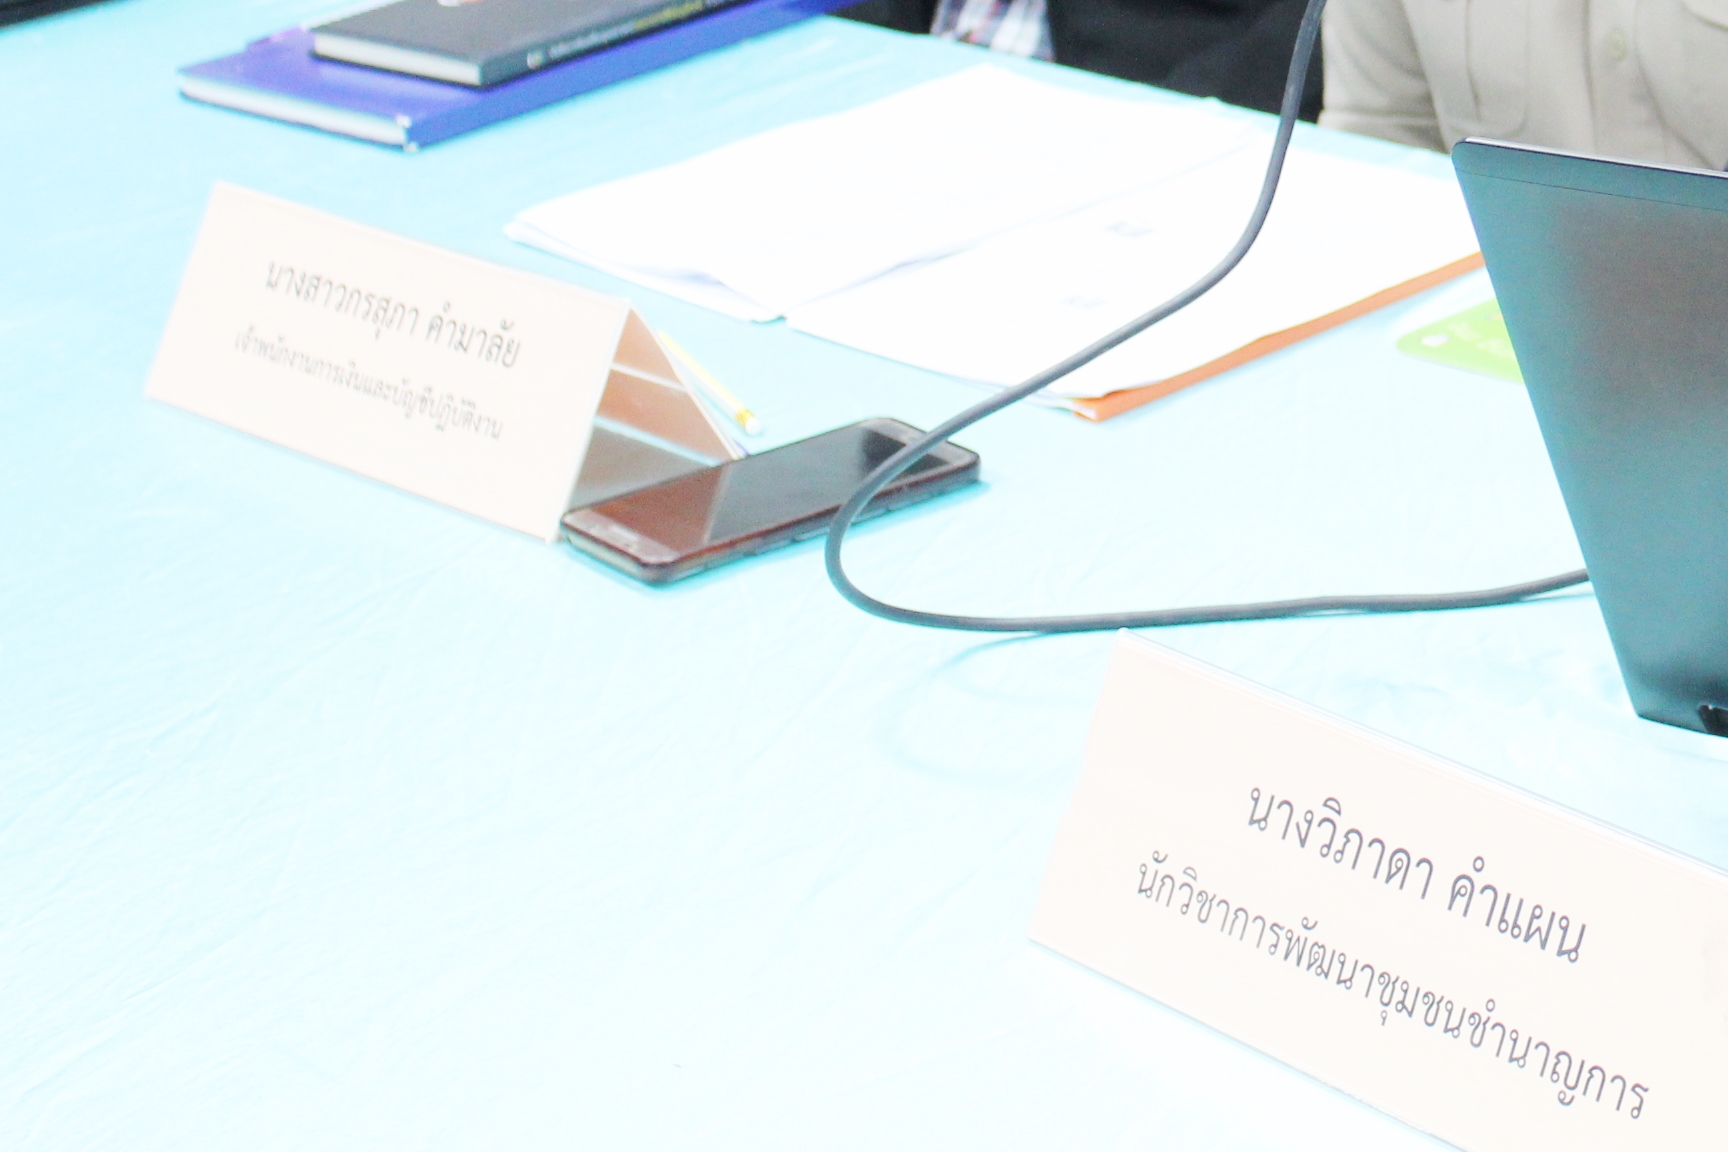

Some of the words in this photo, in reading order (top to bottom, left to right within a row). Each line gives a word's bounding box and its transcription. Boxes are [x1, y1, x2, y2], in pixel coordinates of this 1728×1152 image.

[234, 323, 504, 441] เจ้าพนักงานการเงินและบัญชีปฏิบัติงาน
[265, 260, 420, 340] นางสาวกรสุภา
[425, 301, 522, 369] คำมาลัย
[1246, 784, 1435, 901] นางวิภาดา
[1448, 856, 1588, 966] คำแผน
[1137, 850, 1651, 1121] นักวิชาการพัฒนาชุมชนชำนาญการ
